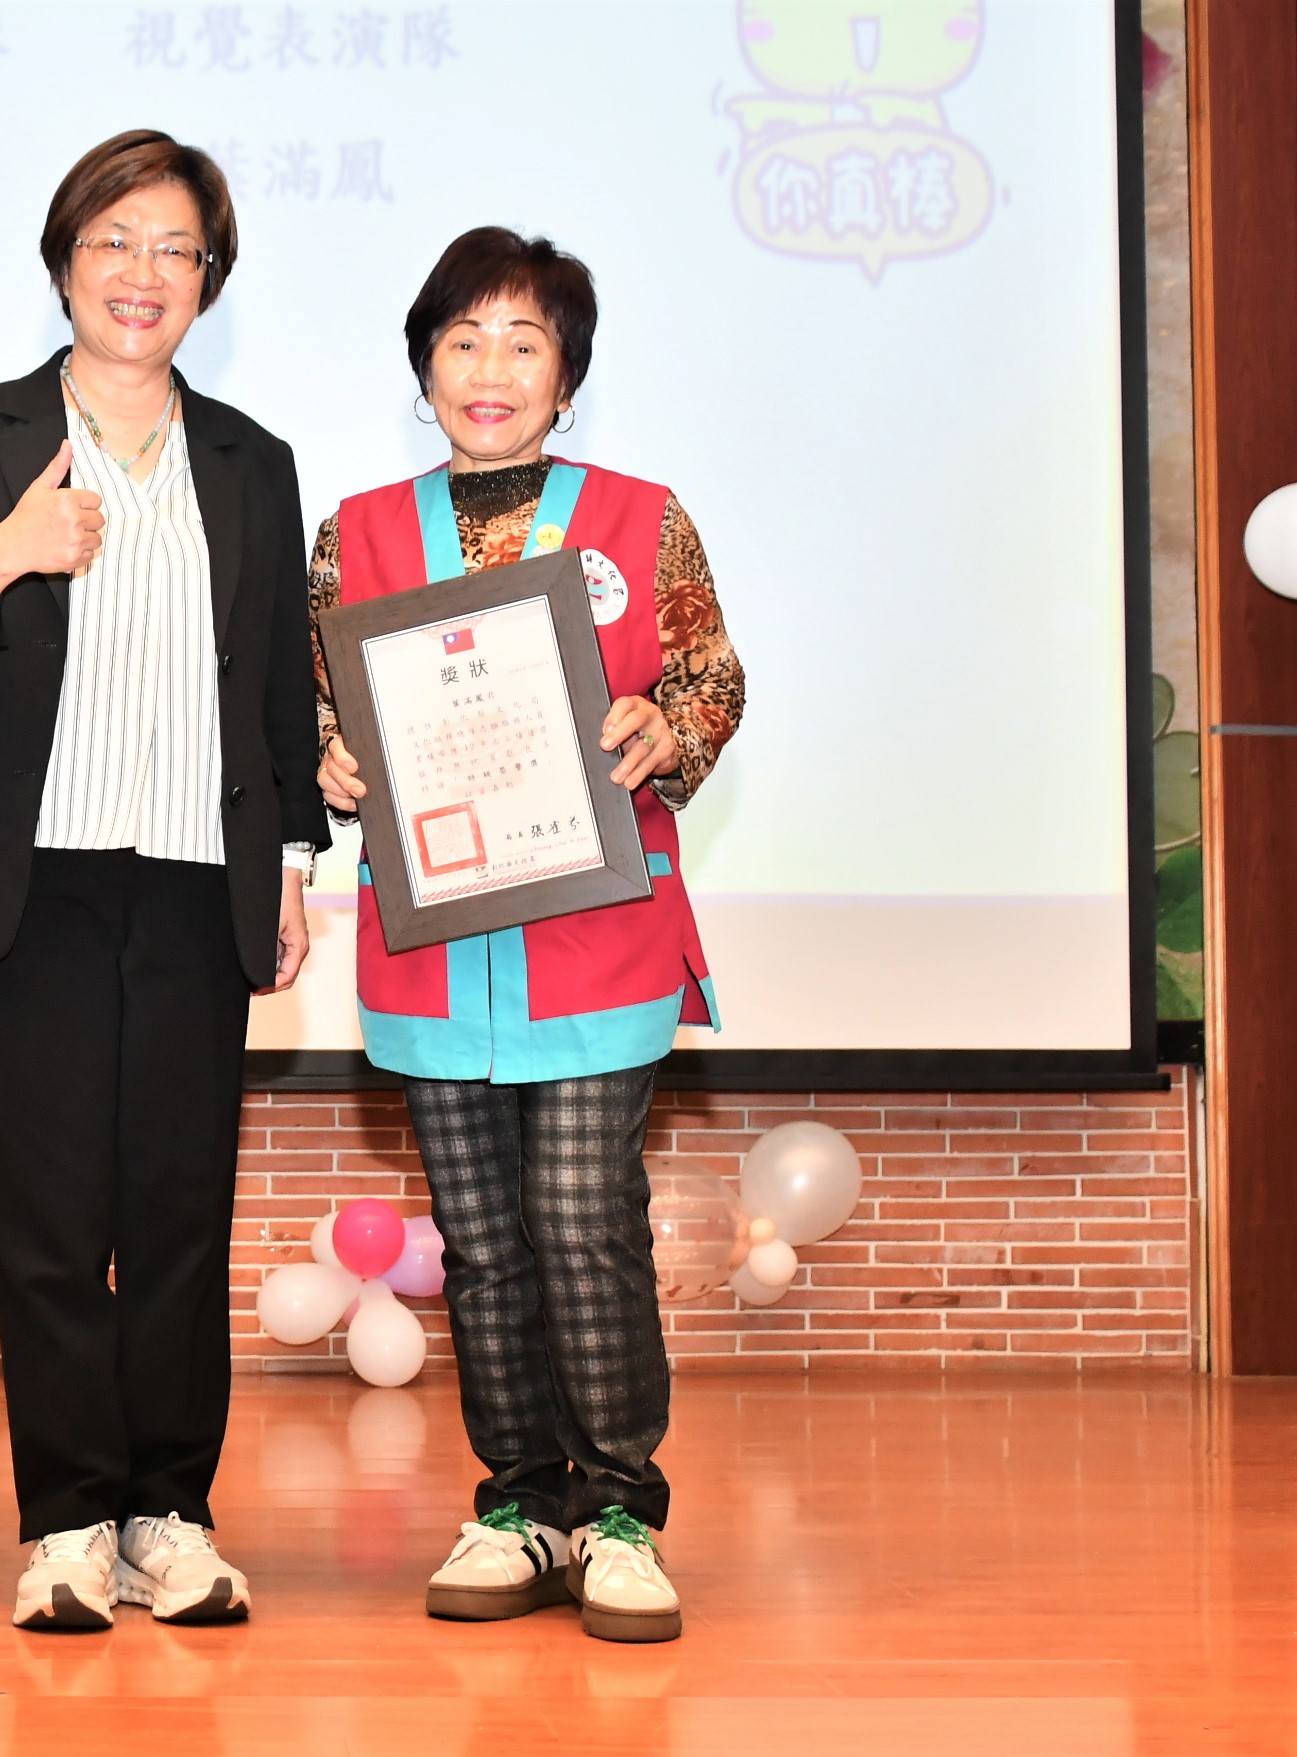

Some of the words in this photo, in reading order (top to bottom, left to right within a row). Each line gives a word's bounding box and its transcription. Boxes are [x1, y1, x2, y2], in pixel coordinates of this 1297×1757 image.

[123, 3, 462, 73] 視覺表演隊
[757, 147, 956, 239] 你真棒
[440, 658, 489, 685] 獎狀
